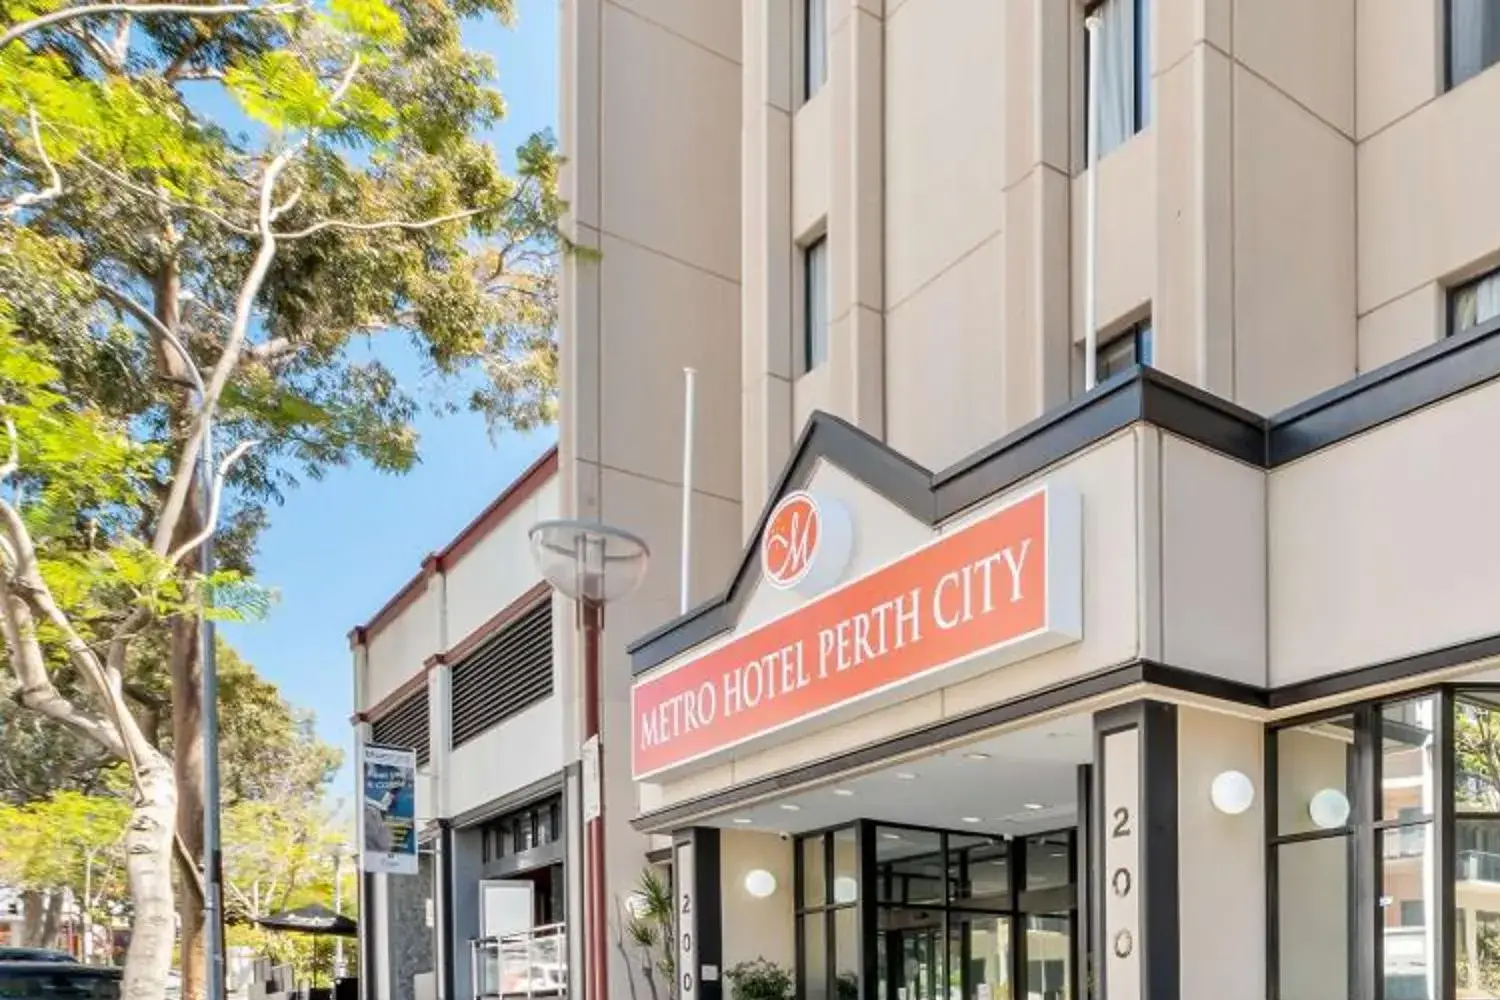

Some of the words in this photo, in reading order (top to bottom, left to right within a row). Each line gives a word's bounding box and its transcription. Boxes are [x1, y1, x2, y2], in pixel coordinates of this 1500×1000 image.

[640, 680, 716, 751] METRO
[723, 640, 811, 717] HOTEL
[817, 586, 923, 678] PERTH
[933, 537, 1032, 630] CITY
[681, 893, 692, 993] 200
[1112, 806, 1133, 959] 200
